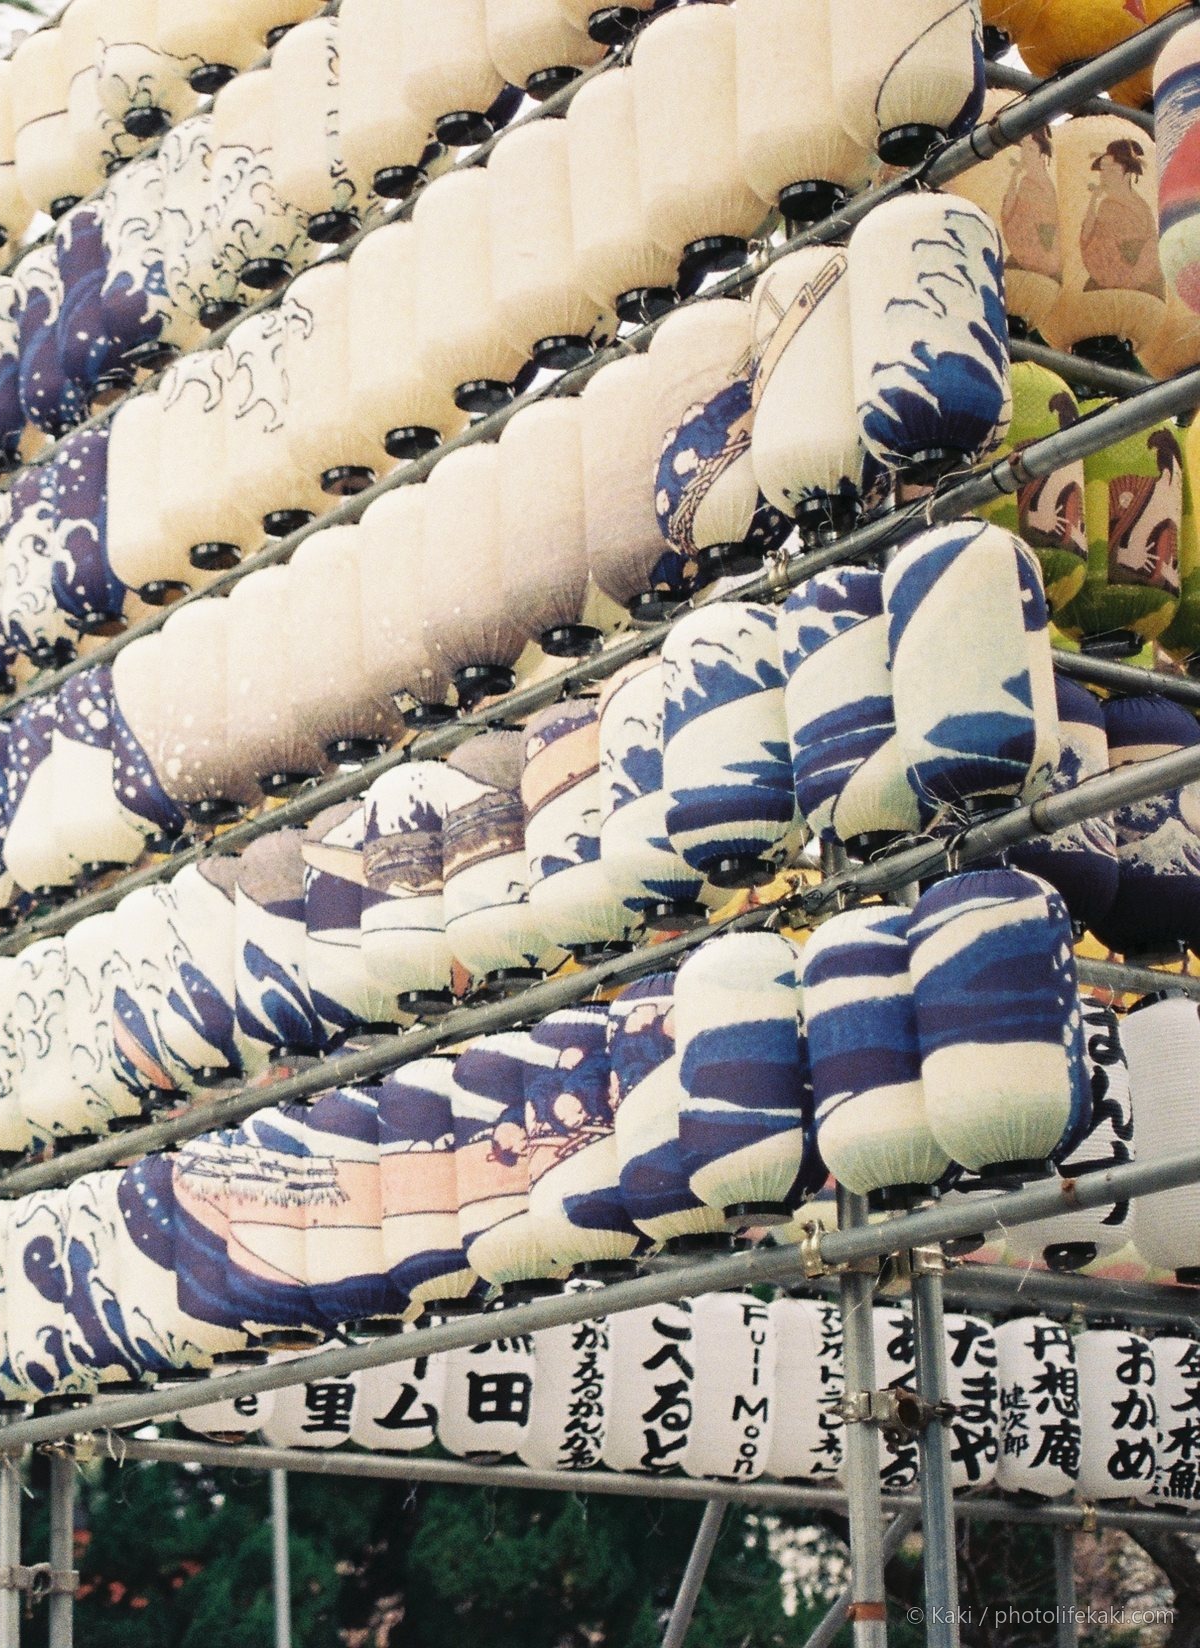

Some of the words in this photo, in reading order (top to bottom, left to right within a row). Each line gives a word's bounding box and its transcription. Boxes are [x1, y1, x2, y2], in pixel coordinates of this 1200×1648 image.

[732, 1395, 769, 1475] Moon
[948, 1320, 998, 1481] たまや
[1000, 1381, 1030, 1458] 健次郎
[1024, 1325, 1081, 1480] 丹想庵
[1107, 1337, 1156, 1481] おかめ
